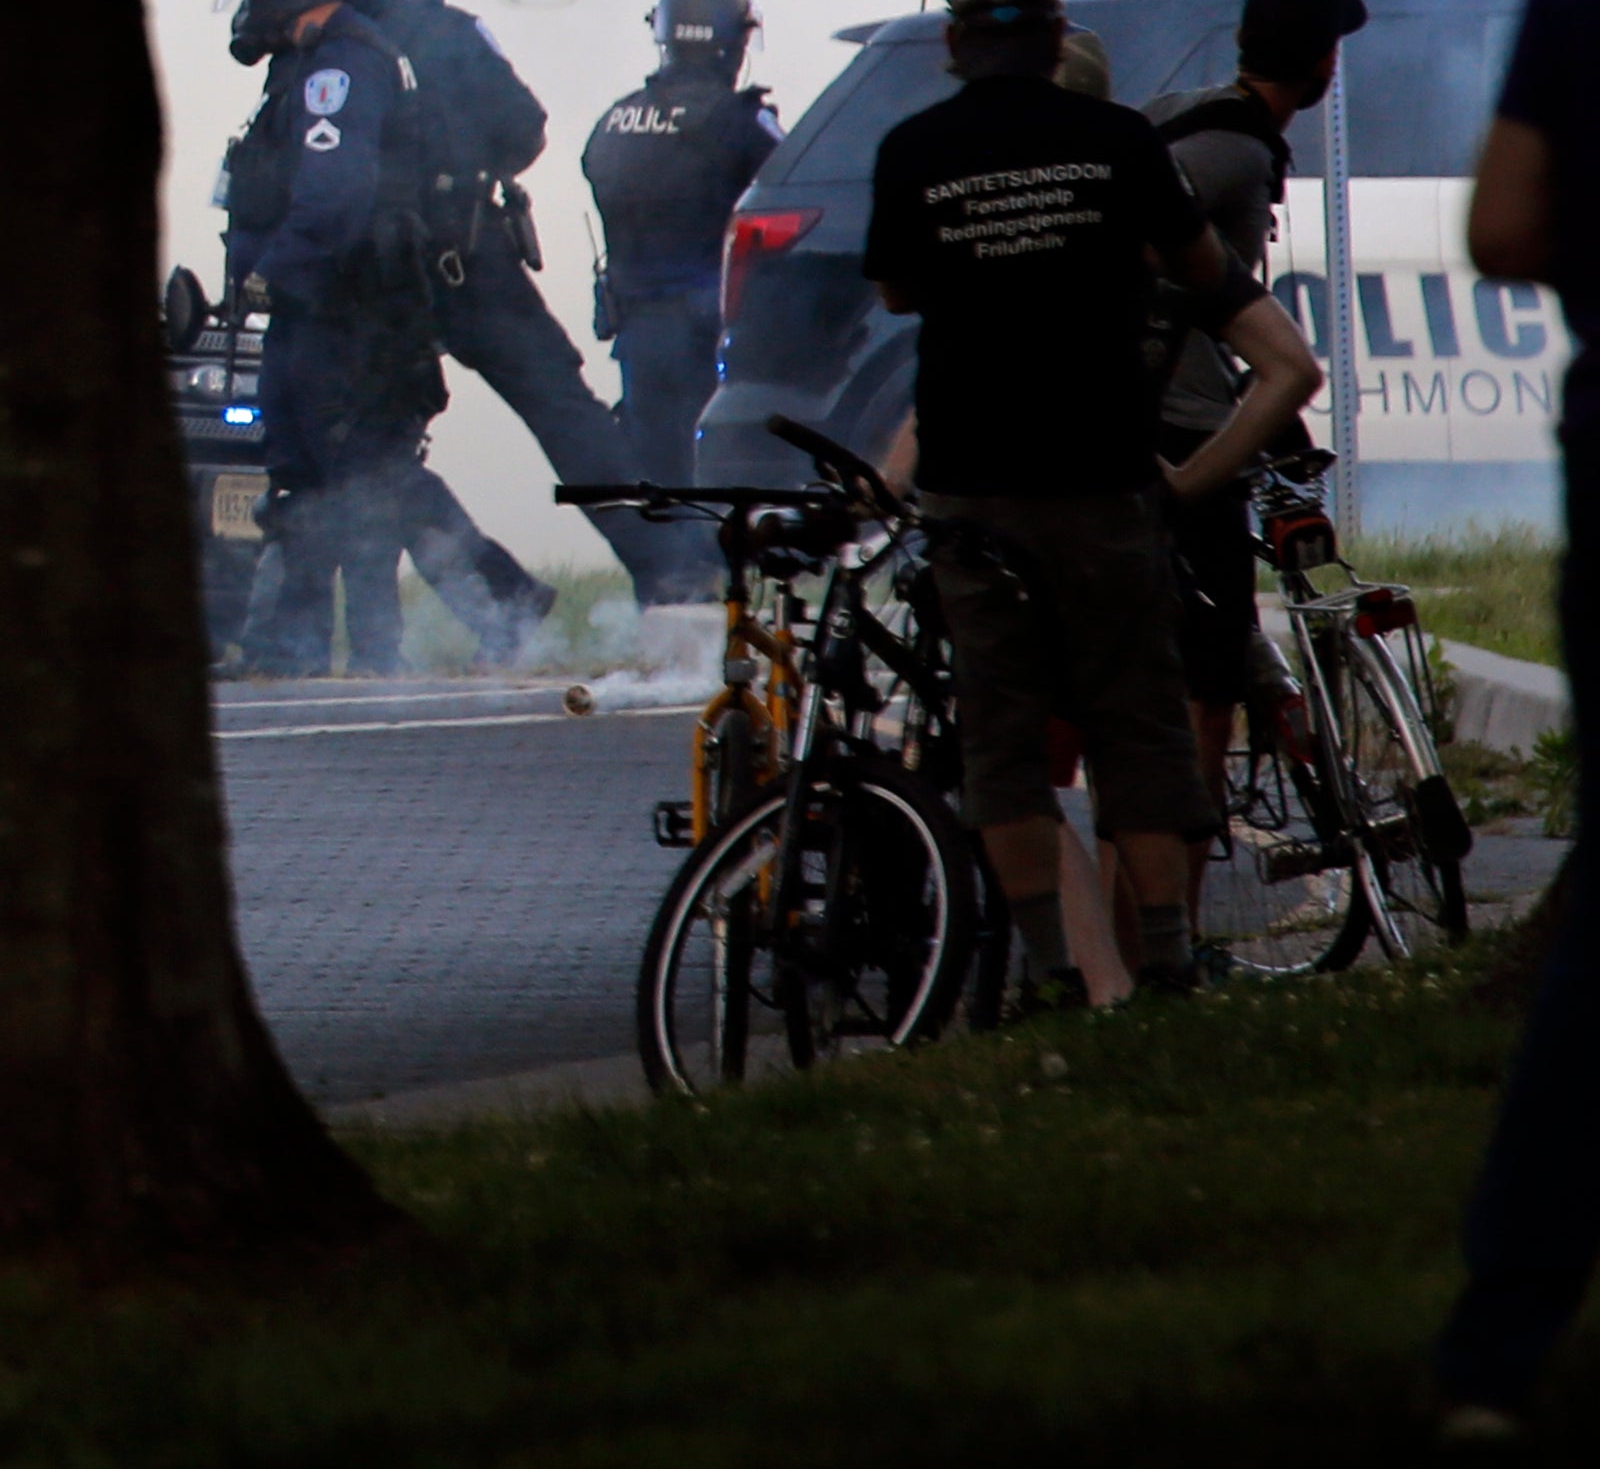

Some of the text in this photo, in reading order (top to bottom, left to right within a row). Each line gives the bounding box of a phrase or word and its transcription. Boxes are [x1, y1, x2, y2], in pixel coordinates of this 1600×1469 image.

[606, 106, 686, 133] POLICE
[925, 164, 1111, 204] SANITETSUNGDOM
[1272, 271, 1548, 360] OLIC
